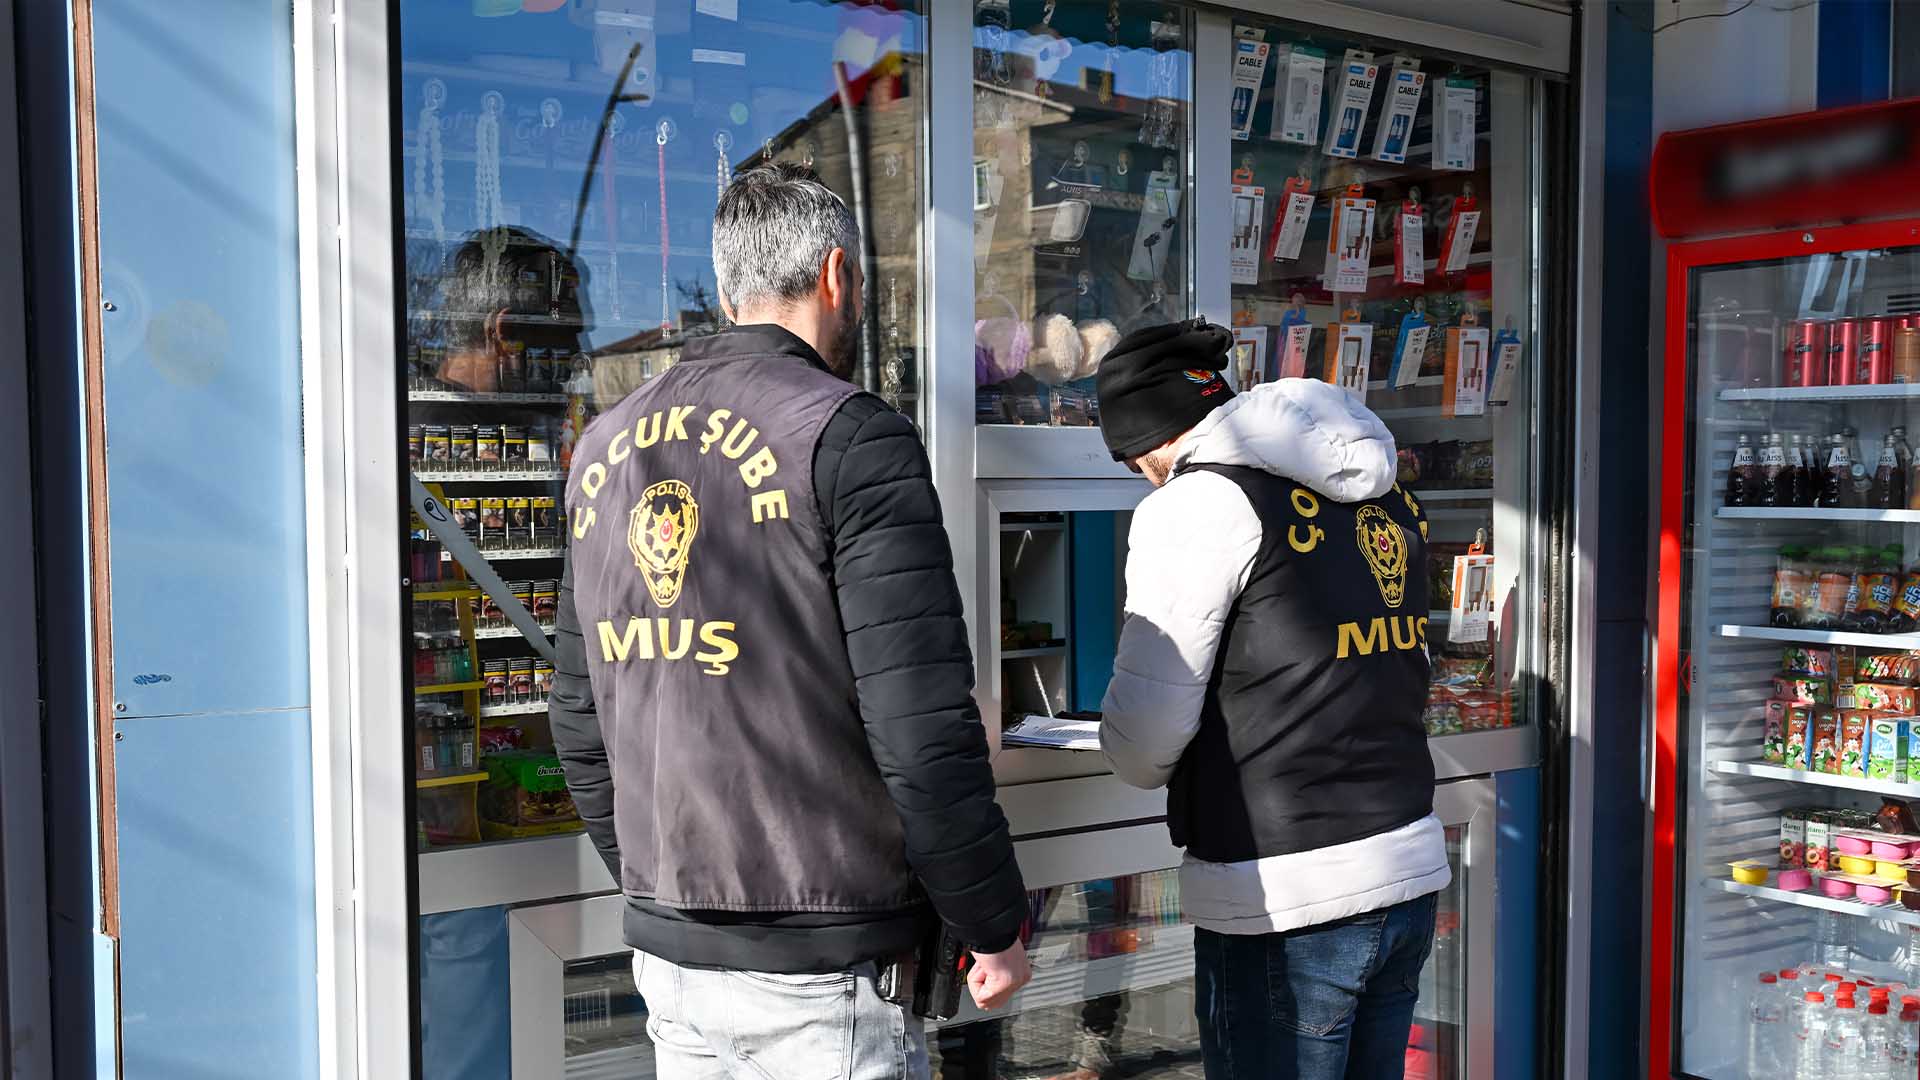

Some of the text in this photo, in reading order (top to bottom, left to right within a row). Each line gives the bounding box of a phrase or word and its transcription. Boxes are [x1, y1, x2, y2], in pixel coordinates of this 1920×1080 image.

[1239, 56, 1263, 68] CABLE
[1349, 78, 1372, 90] CABLE
[1398, 86, 1419, 97] CABLE
[573, 405, 790, 540] ÇOCUK ŞUBE
[597, 616, 739, 676] MUŞ
